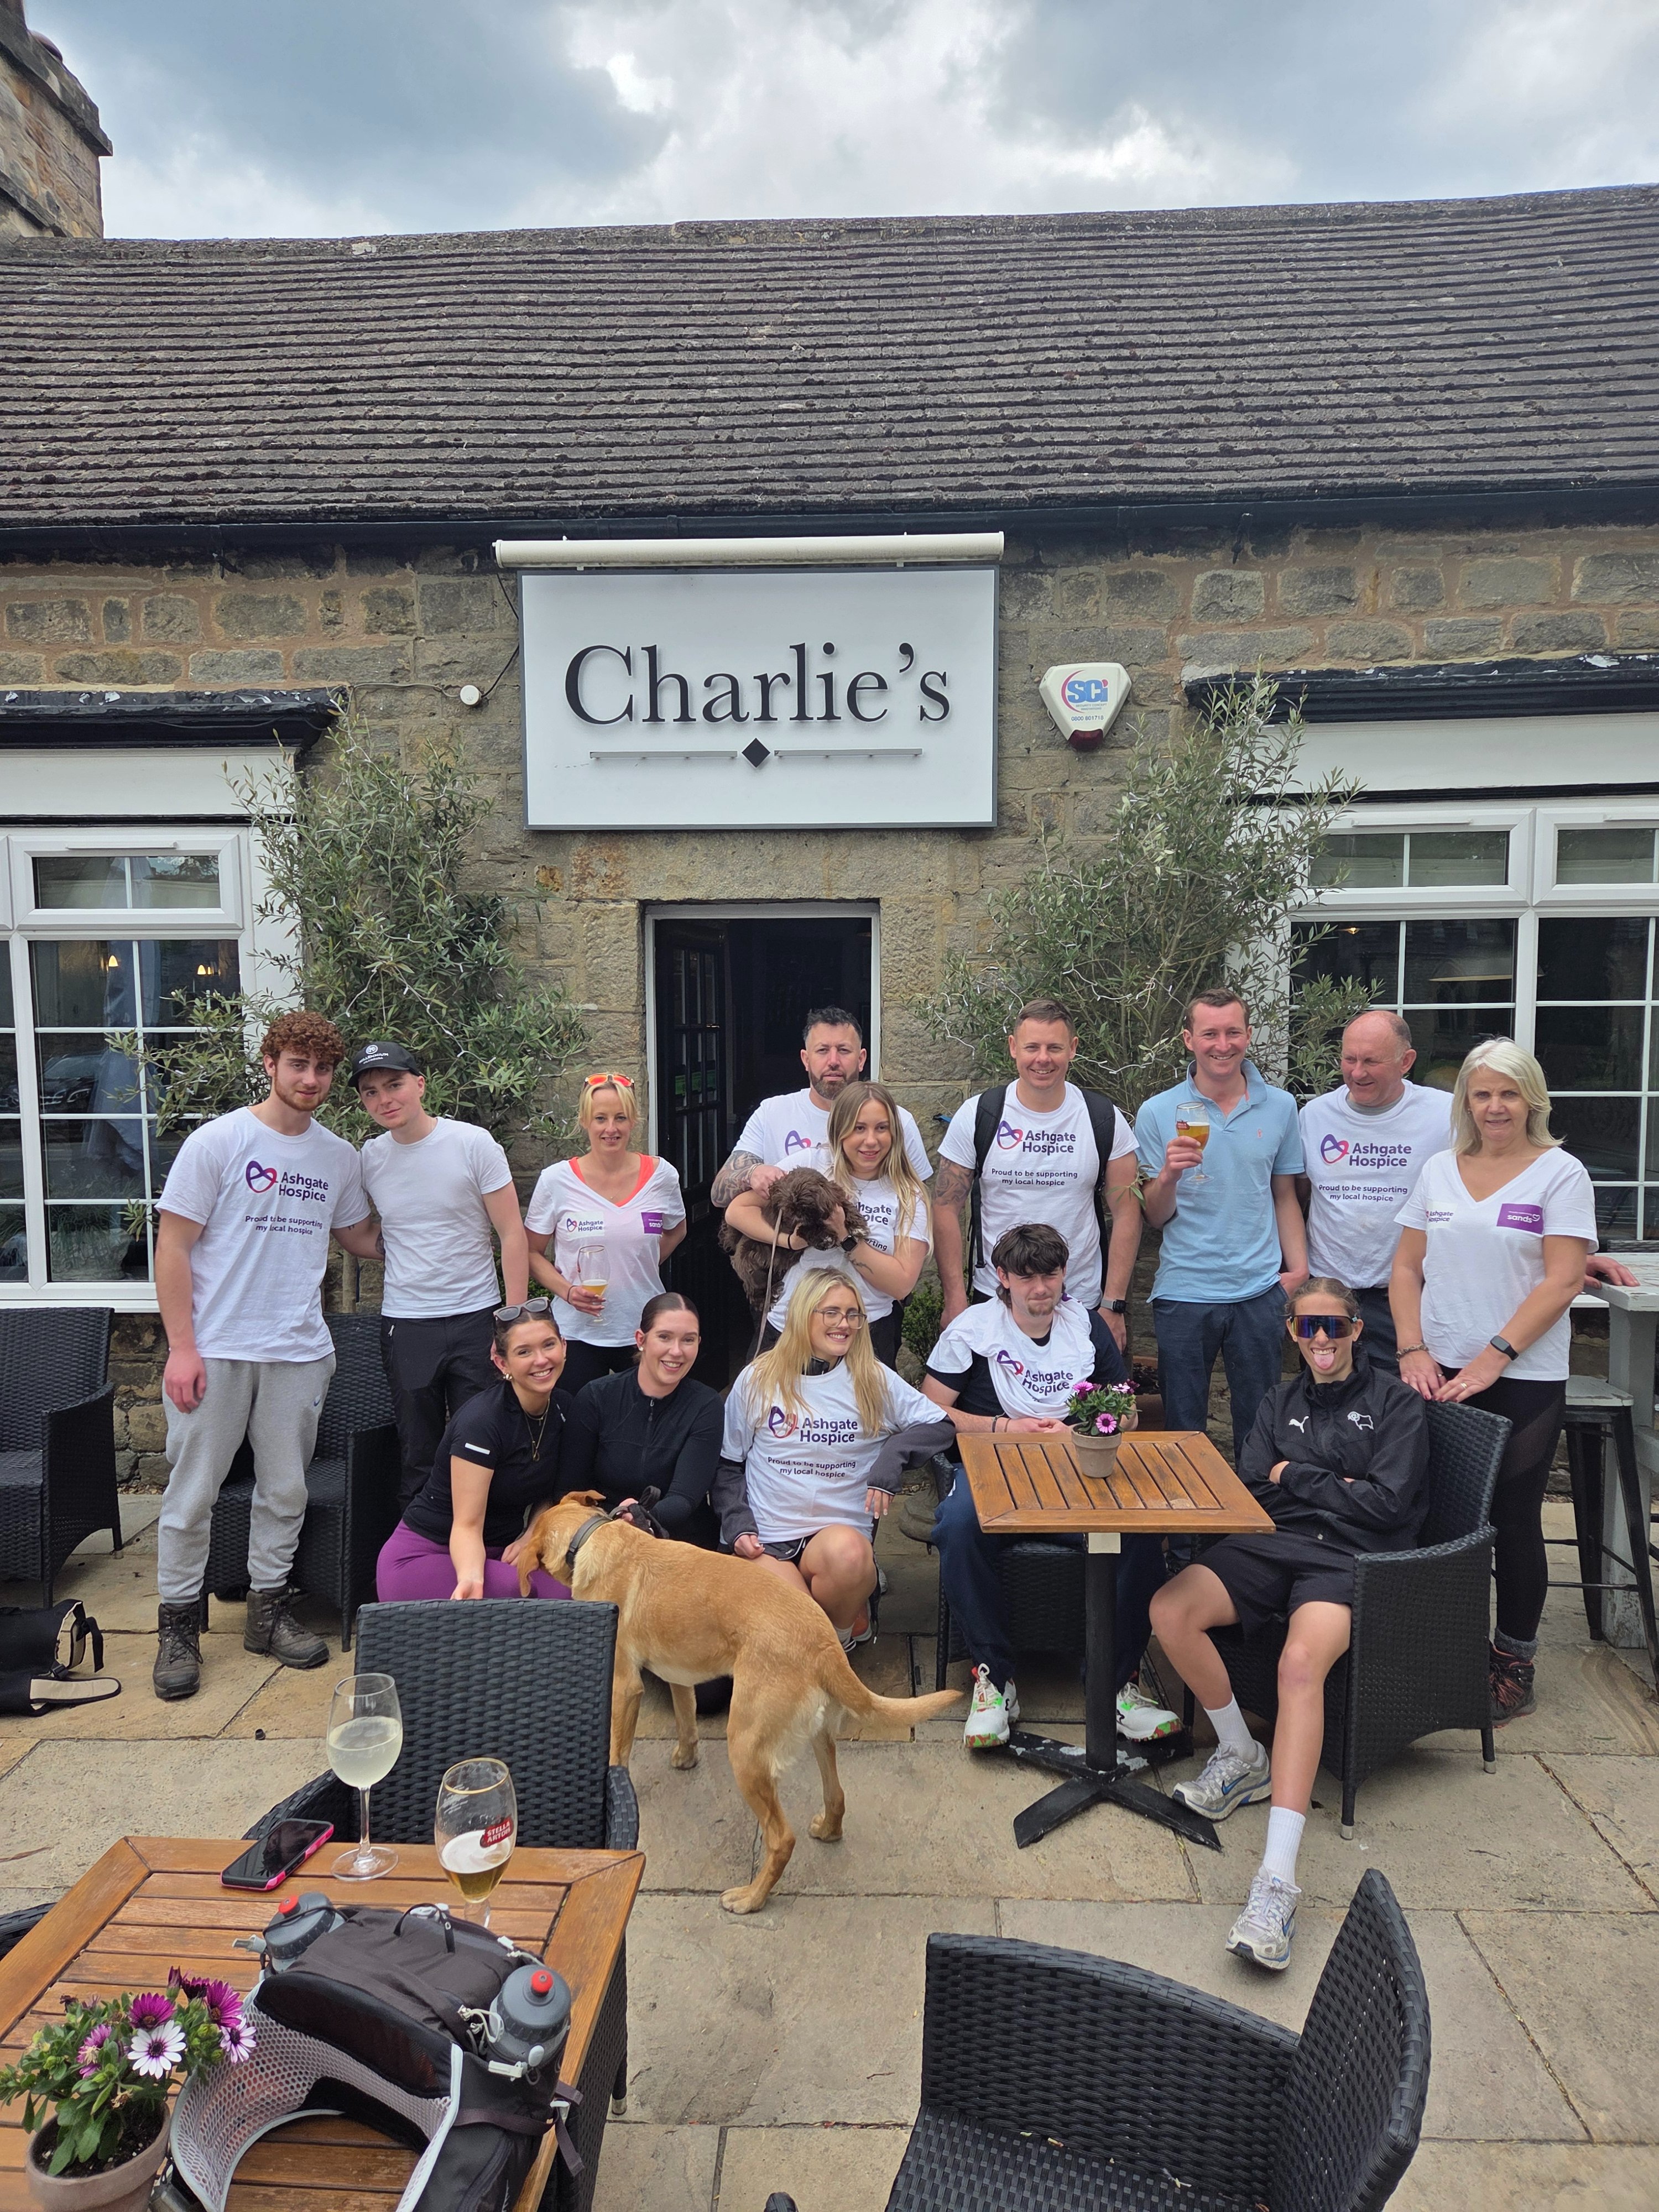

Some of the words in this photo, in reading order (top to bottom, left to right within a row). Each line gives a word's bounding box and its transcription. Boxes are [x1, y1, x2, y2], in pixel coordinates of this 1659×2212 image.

[565, 643, 951, 725] Charlie's
[1025, 1130, 1076, 1144] Ashgate
[1022, 1141, 1074, 1156] Hospice
[1352, 1142, 1412, 1157] Ashgate
[1349, 1155, 1407, 1169] Hospice
[281, 1171, 328, 1190] Ashgate
[279, 1184, 326, 1202] Hospice
[1363, 1186, 1408, 1194] supporting
[858, 1202, 892, 1215] hgate
[289, 1217, 323, 1229] supporting
[863, 1213, 889, 1225] pice
[1507, 1214, 1532, 1223] sands
[288, 1225, 313, 1235] hospice
[1025, 1369, 1073, 1384] Ashgate
[1022, 1378, 1070, 1396] Hospice
[802, 1417, 858, 1432] Ashgate
[800, 1430, 855, 1446] Hospice
[768, 1457, 790, 1465] Proud
[816, 1461, 856, 1470] supporting
[815, 1470, 846, 1478] hospice
[487, 1821, 510, 1837] STELLA
